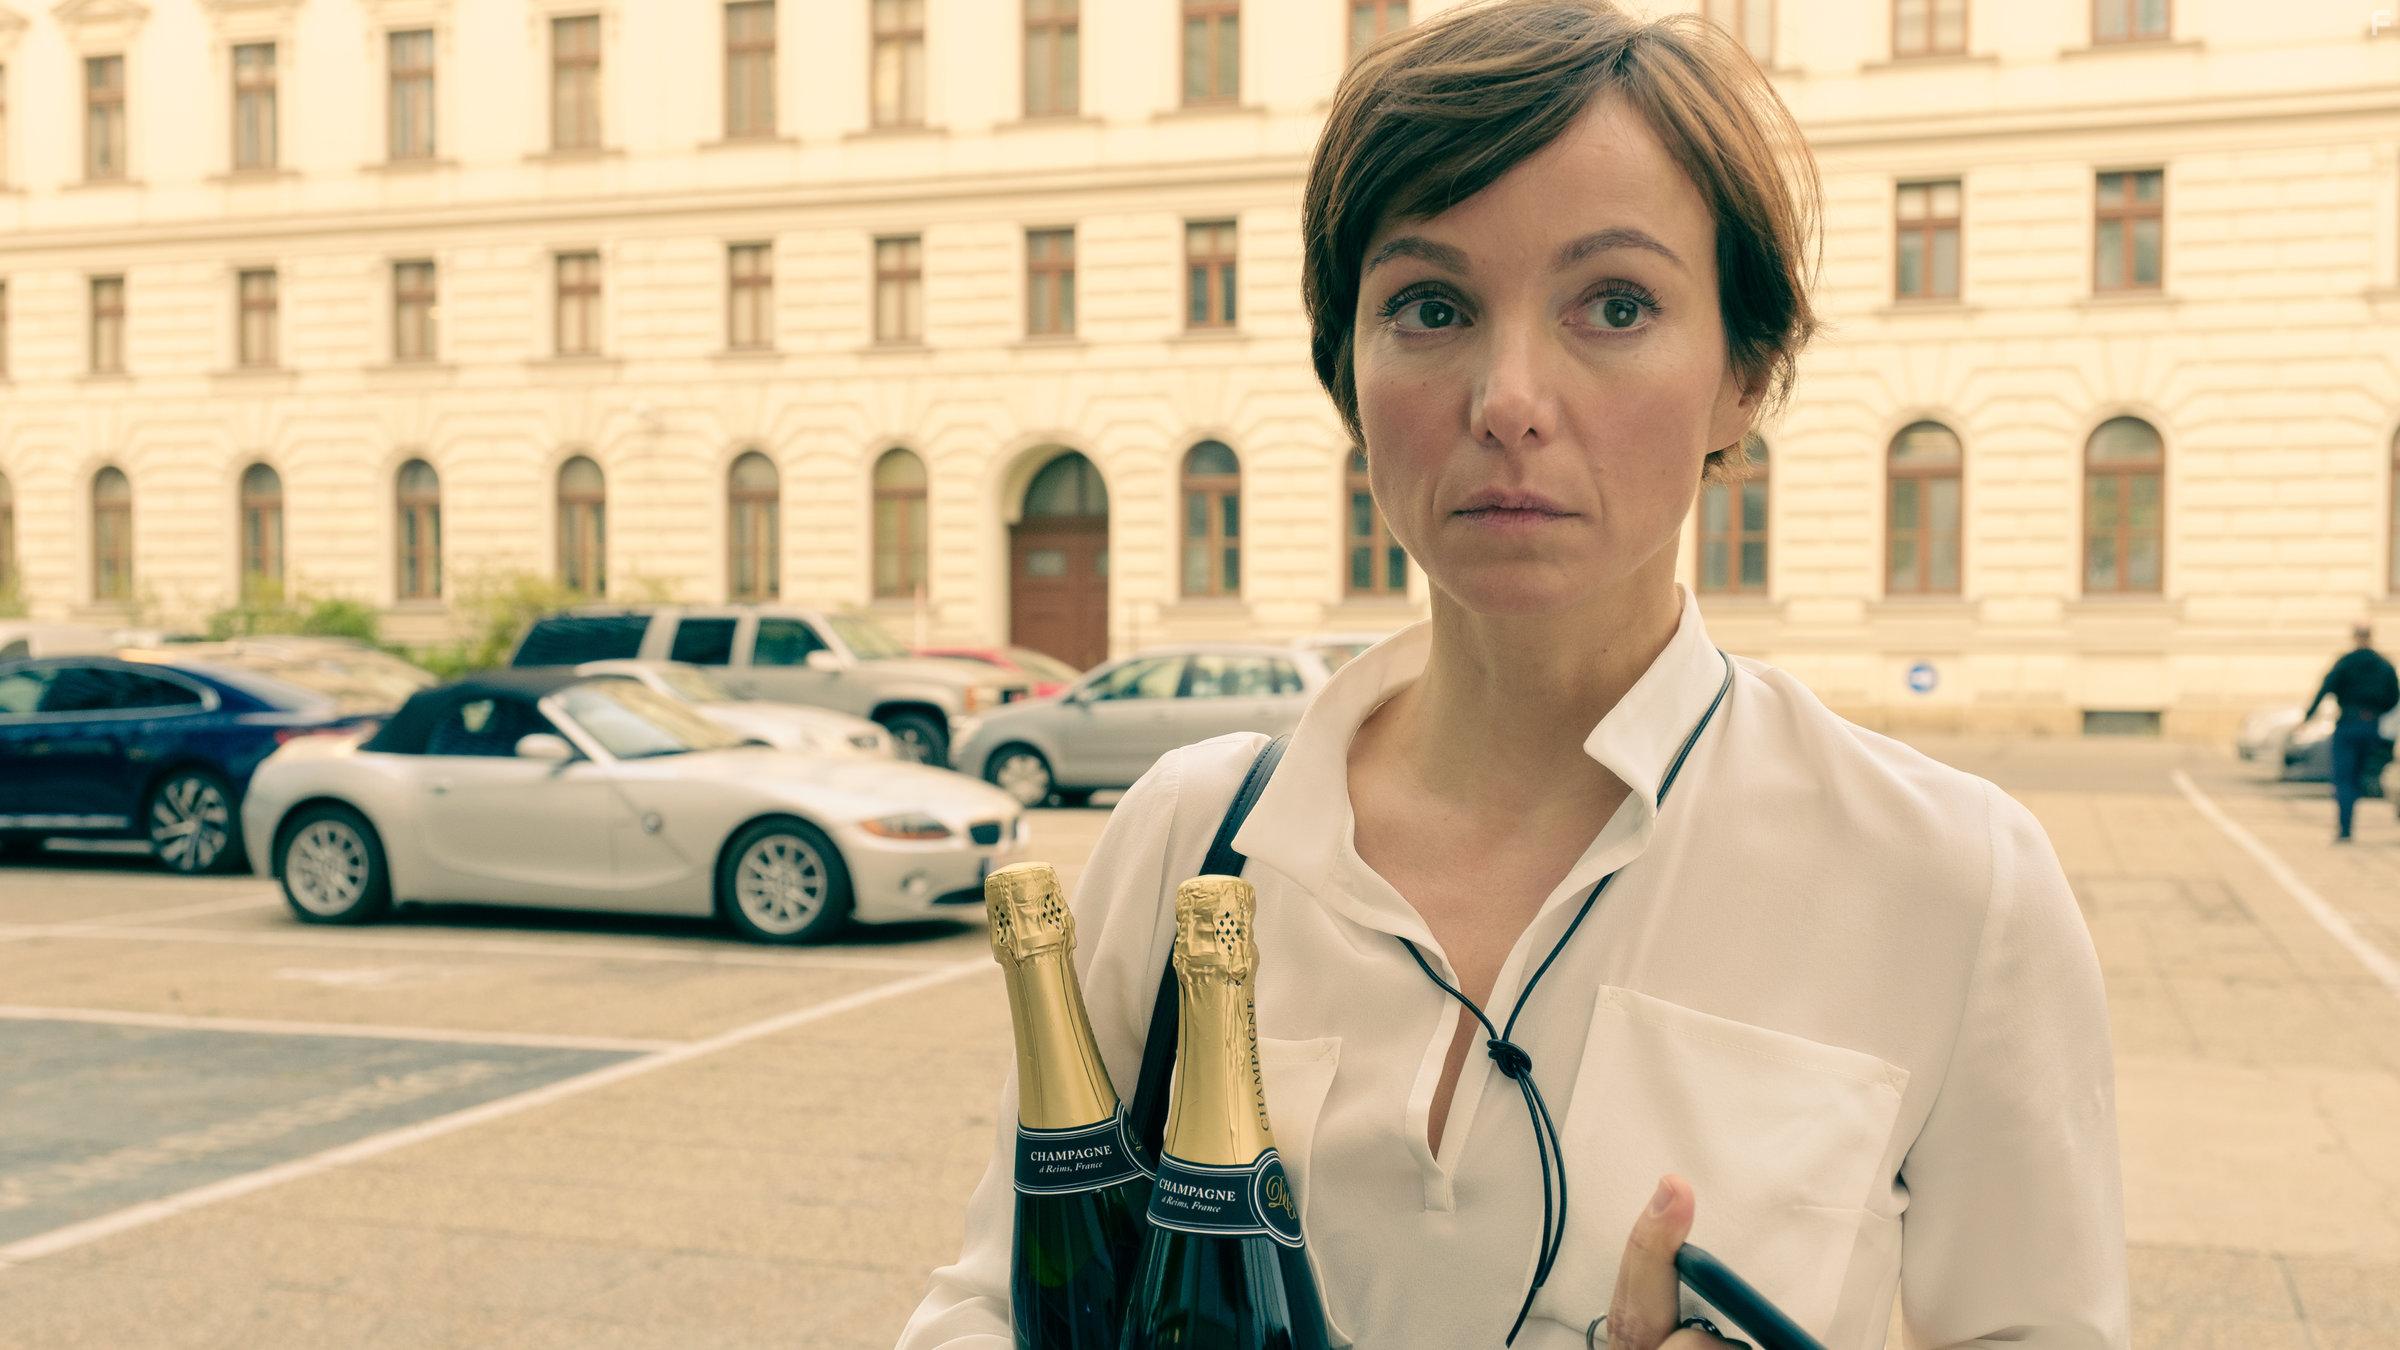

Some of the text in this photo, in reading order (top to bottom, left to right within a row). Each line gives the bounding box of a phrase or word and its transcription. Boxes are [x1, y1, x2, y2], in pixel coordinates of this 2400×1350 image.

[1246, 998, 1270, 1132] CHAMPAGNE
[1030, 1145, 1113, 1162] CHAMPAGNE
[1075, 1162, 1103, 1171] France
[1159, 1178, 1236, 1202] CHAMPAGNE
[1191, 1201, 1221, 1213] France
